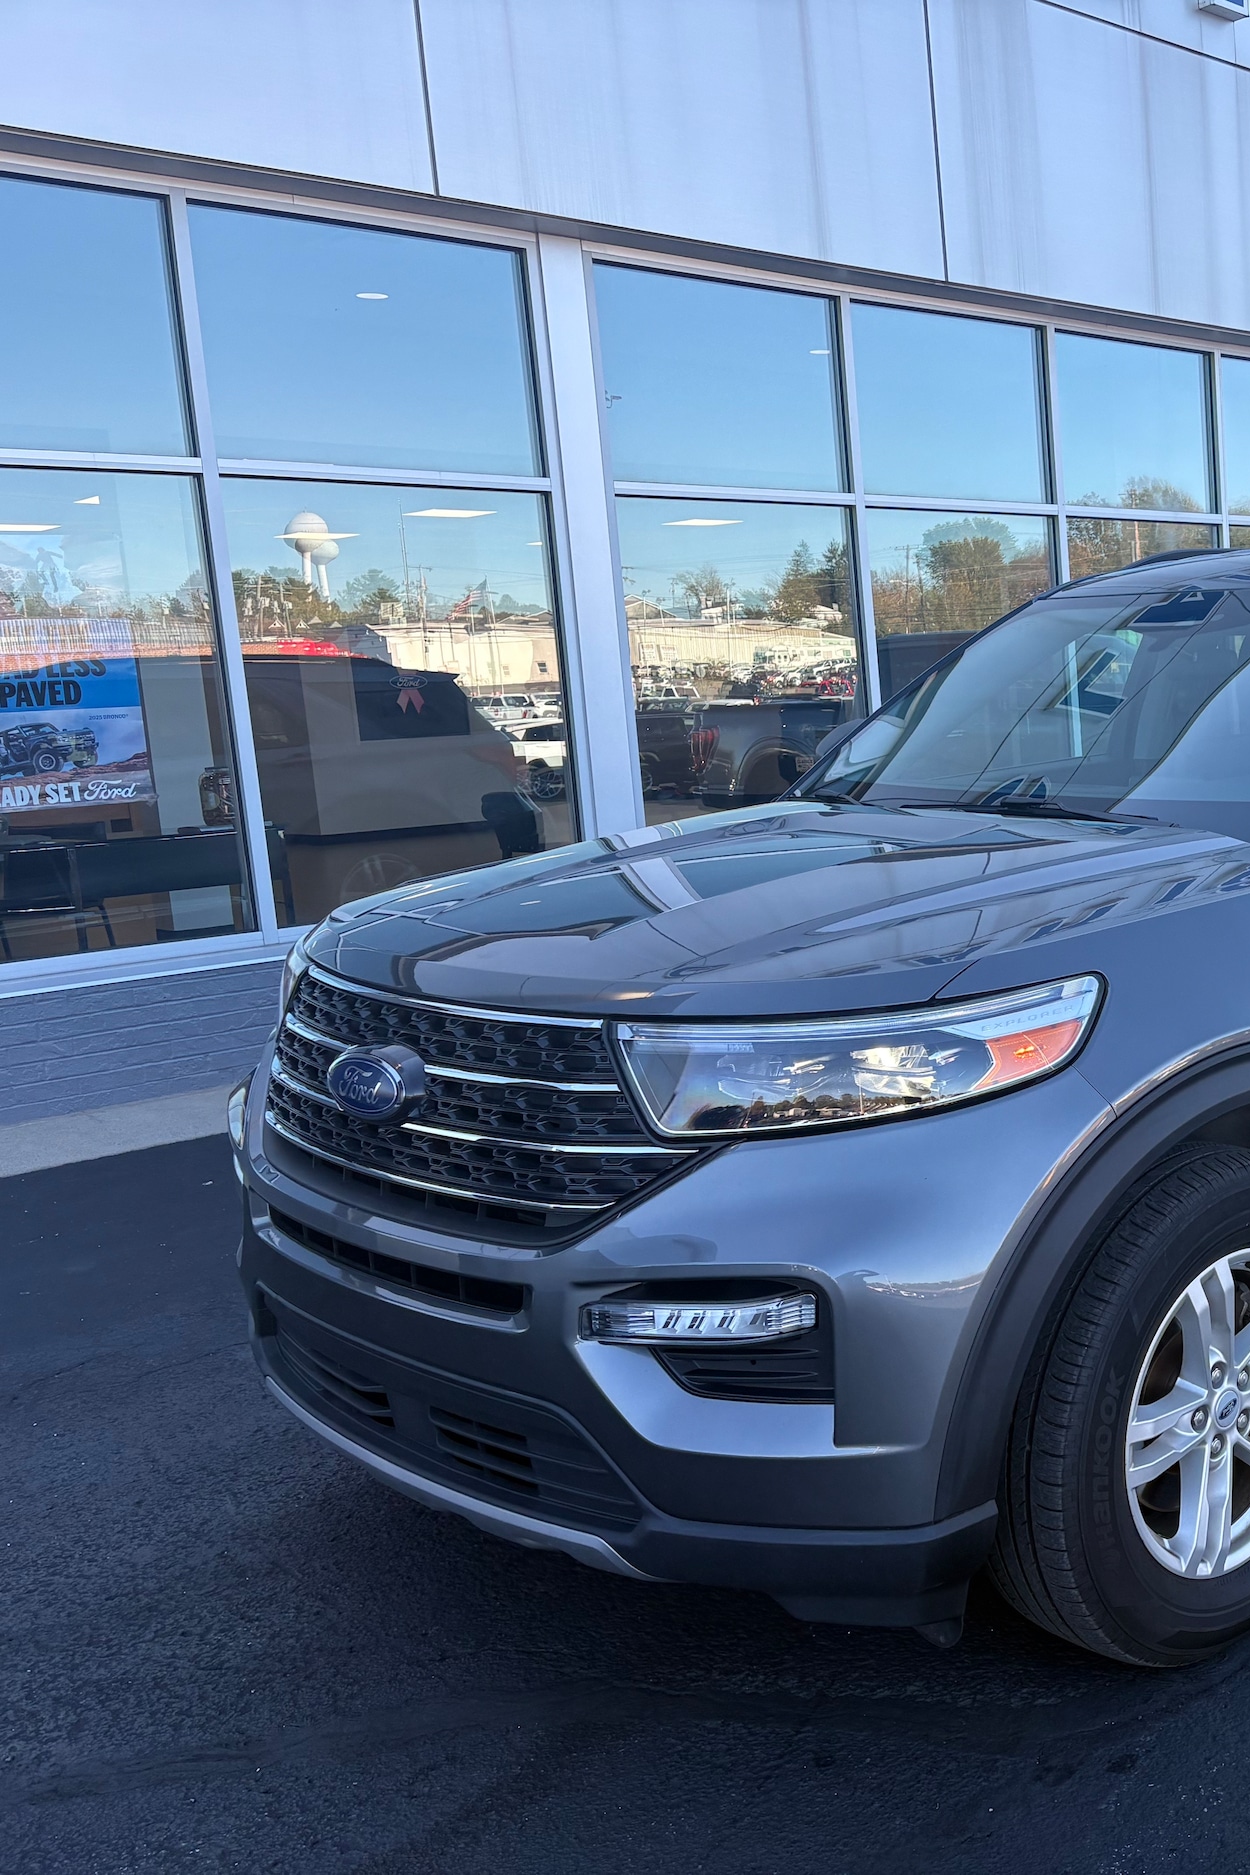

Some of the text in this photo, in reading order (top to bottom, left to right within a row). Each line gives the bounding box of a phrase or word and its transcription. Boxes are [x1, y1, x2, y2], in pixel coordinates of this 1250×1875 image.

[0, 679, 82, 708] PAVED
[44, 782, 81, 804] SET
[84, 779, 138, 801] Ford
[980, 1004, 1075, 1032] EXPLORER
